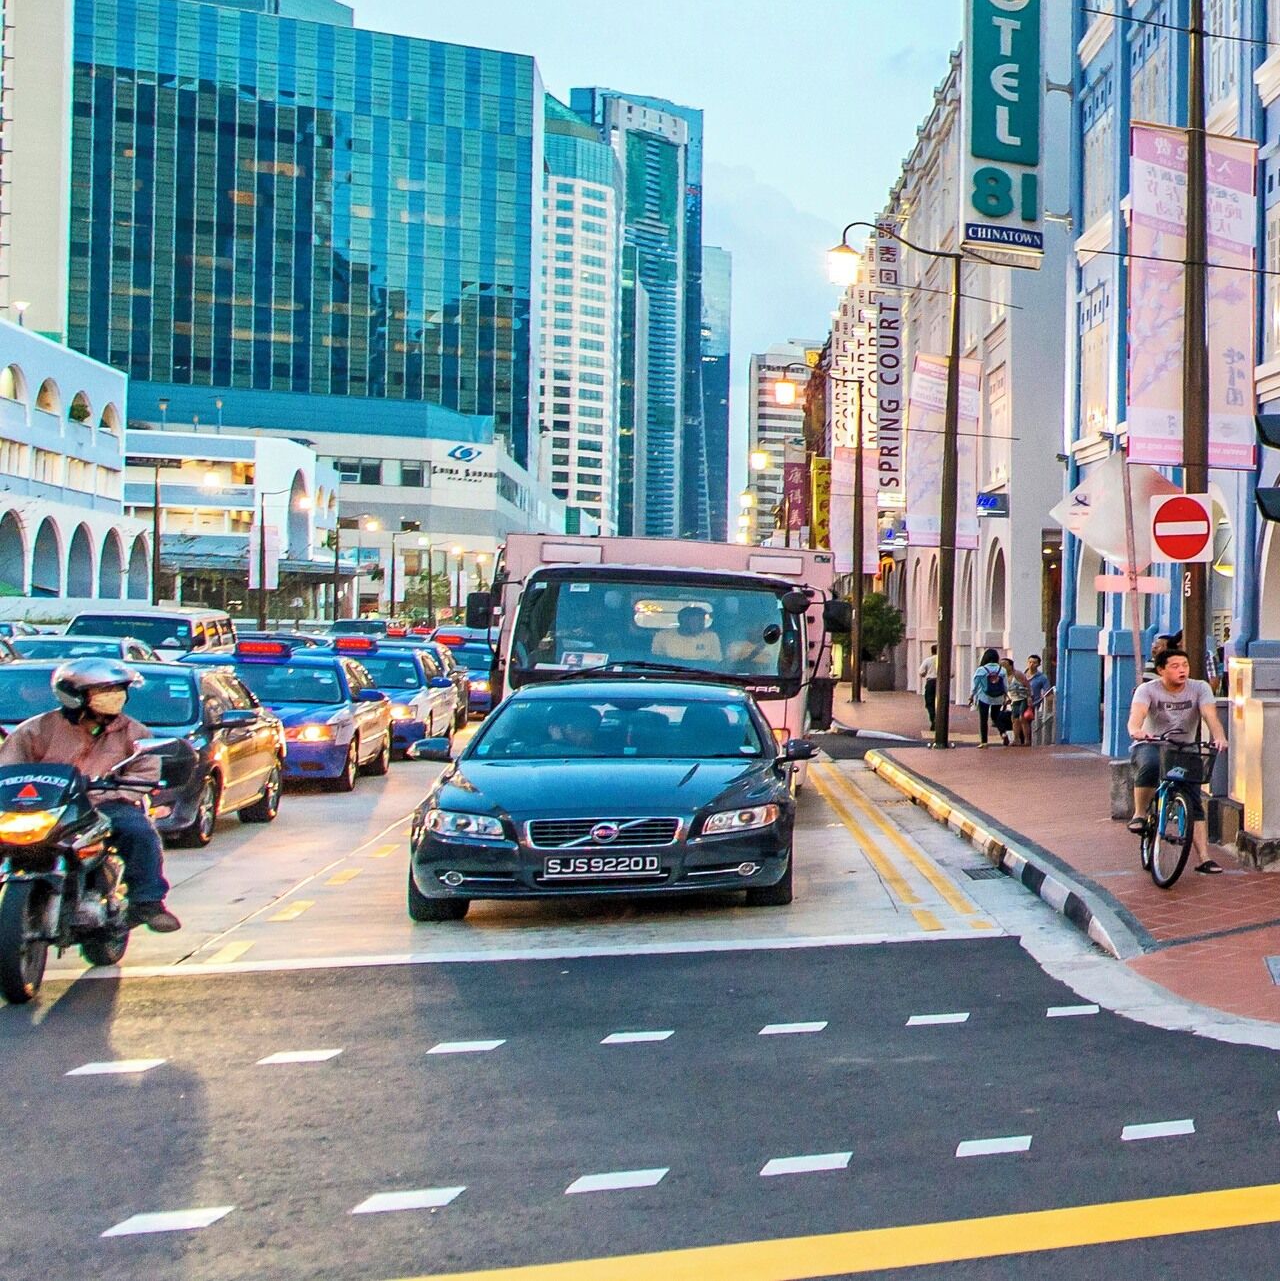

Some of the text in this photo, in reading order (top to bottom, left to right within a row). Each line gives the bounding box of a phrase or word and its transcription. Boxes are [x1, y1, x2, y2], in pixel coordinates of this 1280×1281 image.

[972, 166, 1038, 223] 81
[968, 226, 1042, 246] CHINATOWN
[880, 302, 900, 487] SPRING COURT
[1184, 571, 1192, 597] 25
[548, 856, 659, 874] SJS9220D
